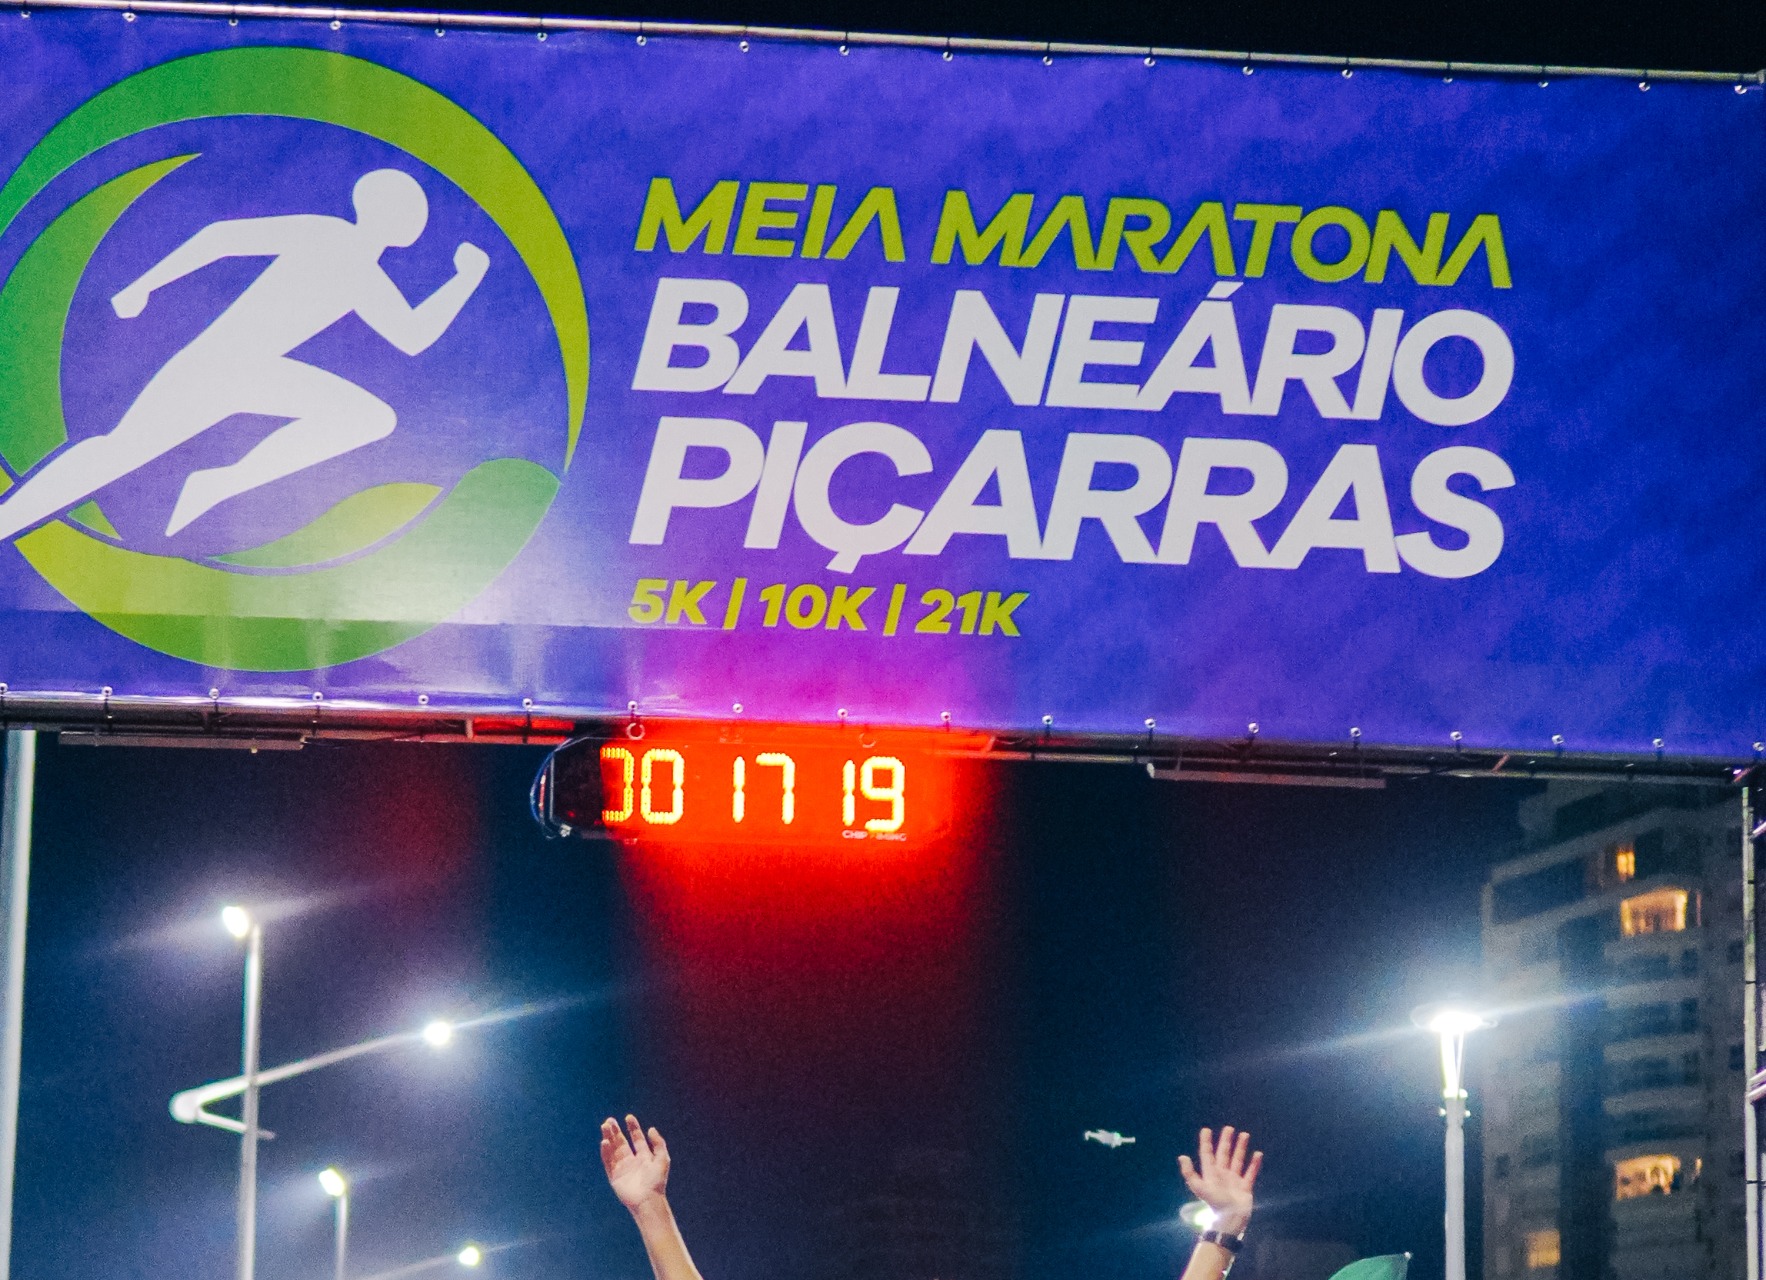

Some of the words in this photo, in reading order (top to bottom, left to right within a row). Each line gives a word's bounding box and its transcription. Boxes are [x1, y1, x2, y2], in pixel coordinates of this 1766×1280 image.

[634, 177, 906, 263] MEIA
[931, 190, 1514, 289] MARATONA
[630, 277, 1516, 427] BALNEÁRIO
[628, 415, 1517, 579] PIÇARRAS
[628, 579, 716, 626] 5K
[757, 584, 877, 633] 10K
[915, 588, 1030, 638] 21K
[732, 752, 795, 824] 17
[842, 756, 905, 832] 19
